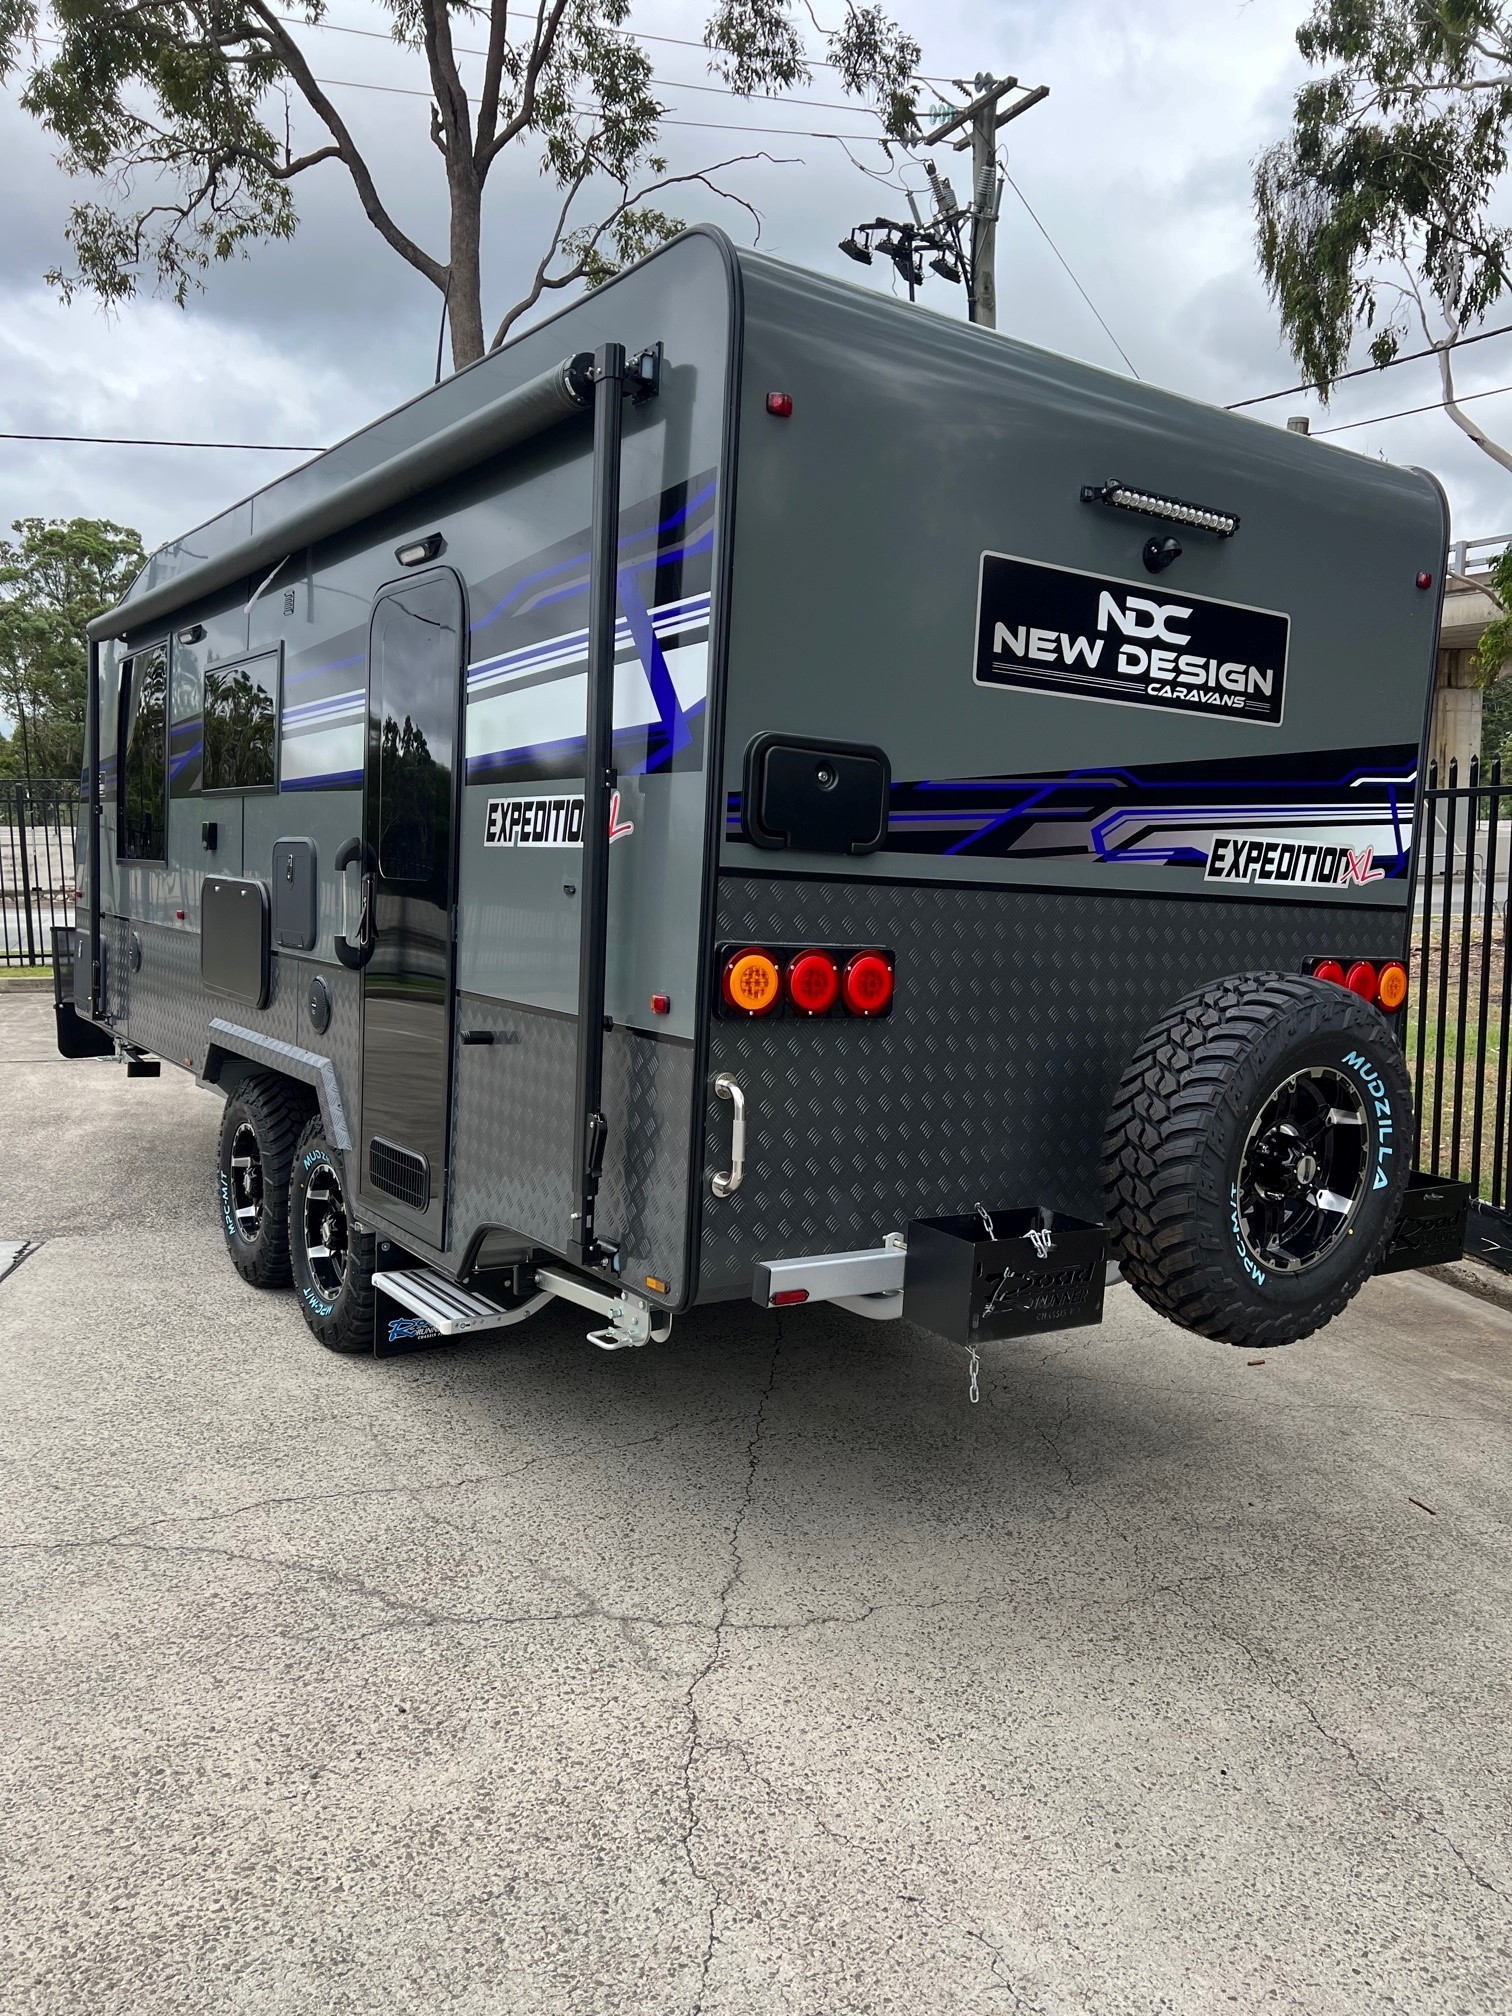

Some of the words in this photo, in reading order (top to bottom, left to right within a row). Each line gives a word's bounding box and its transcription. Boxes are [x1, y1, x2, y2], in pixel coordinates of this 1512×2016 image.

[1097, 590, 1193, 646] NDC
[993, 621, 1105, 669] NEW
[1117, 643, 1274, 697] DESIGN
[1147, 683, 1247, 708] CARAVANS
[485, 798, 585, 843] EXPEDITIO
[1341, 1050, 1393, 1191] MUDZILLA
[220, 1169, 236, 1235] MPC-M/T
[1229, 1181, 1266, 1286] MPC-M/T
